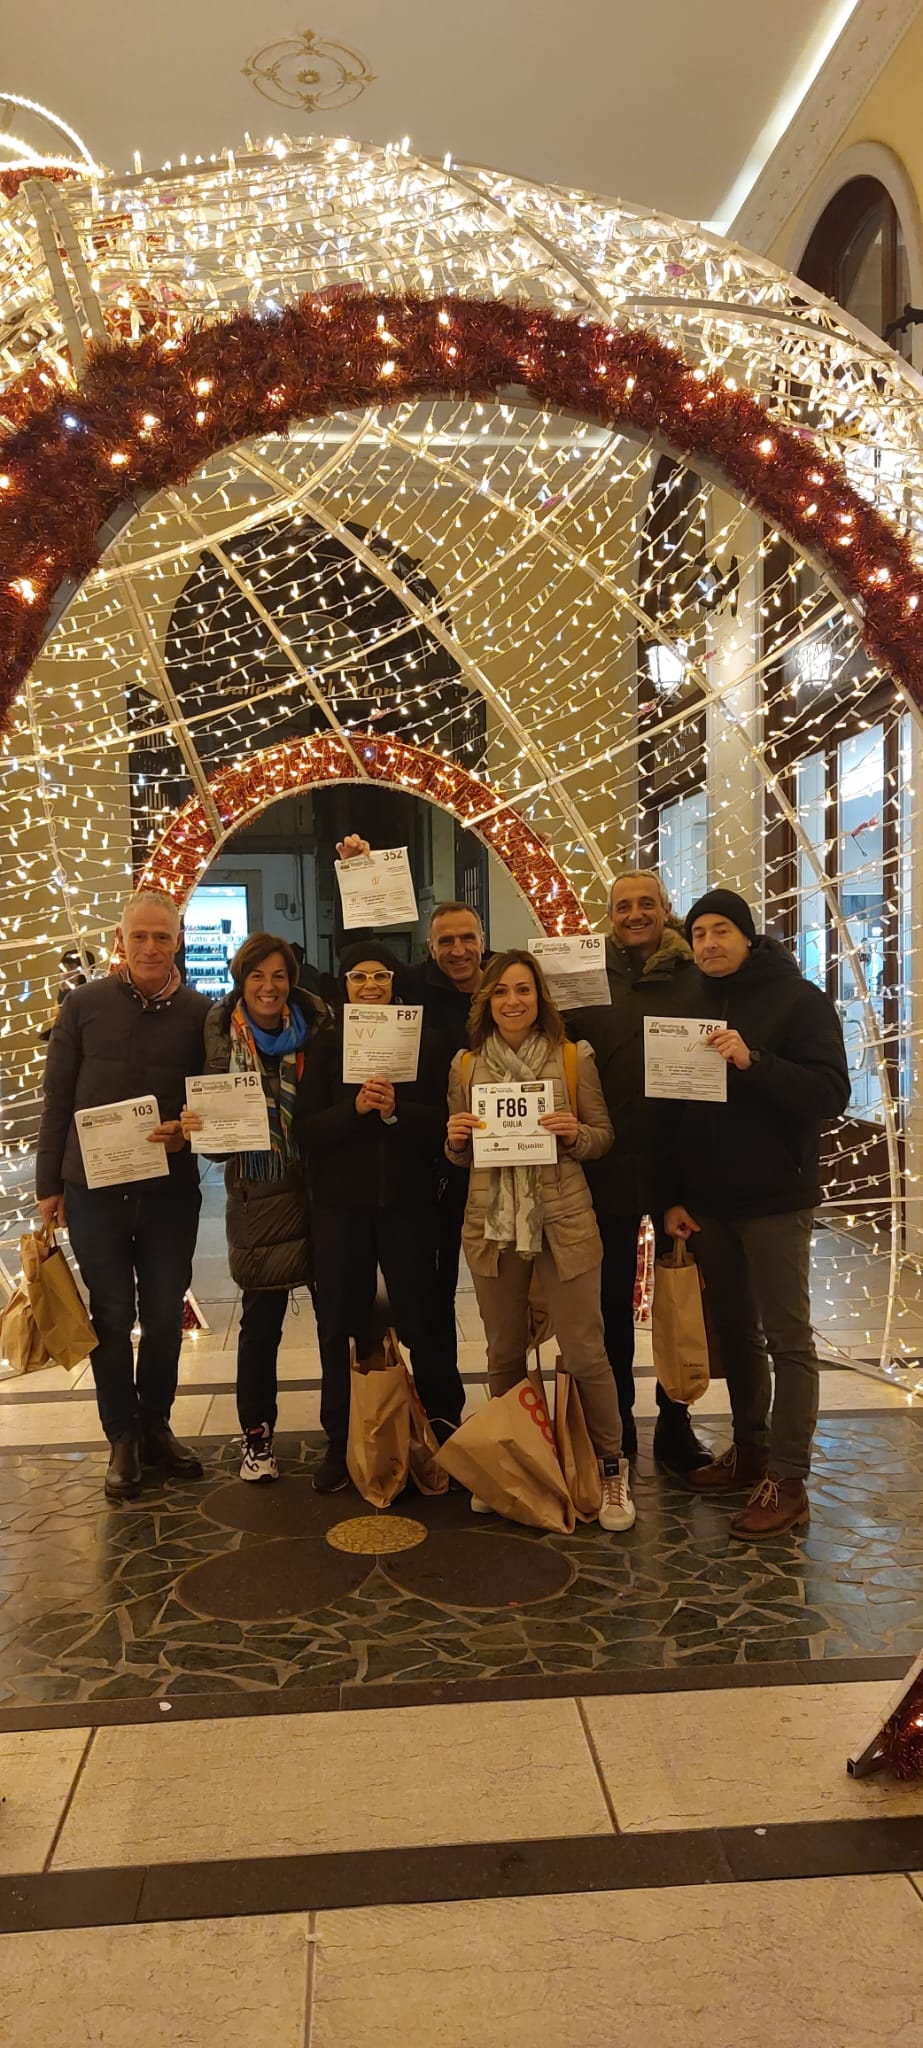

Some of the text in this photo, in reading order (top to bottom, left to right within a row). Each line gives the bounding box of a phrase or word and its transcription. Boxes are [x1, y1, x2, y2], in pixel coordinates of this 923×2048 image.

[216, 677, 293, 697] Gallera
[383, 850, 403, 861] 352
[579, 938, 601, 950] 765
[397, 1009, 418, 1021] F87
[132, 1104, 153, 1117] 103
[496, 1097, 528, 1119] F86
[502, 1120, 523, 1129] GIULIA
